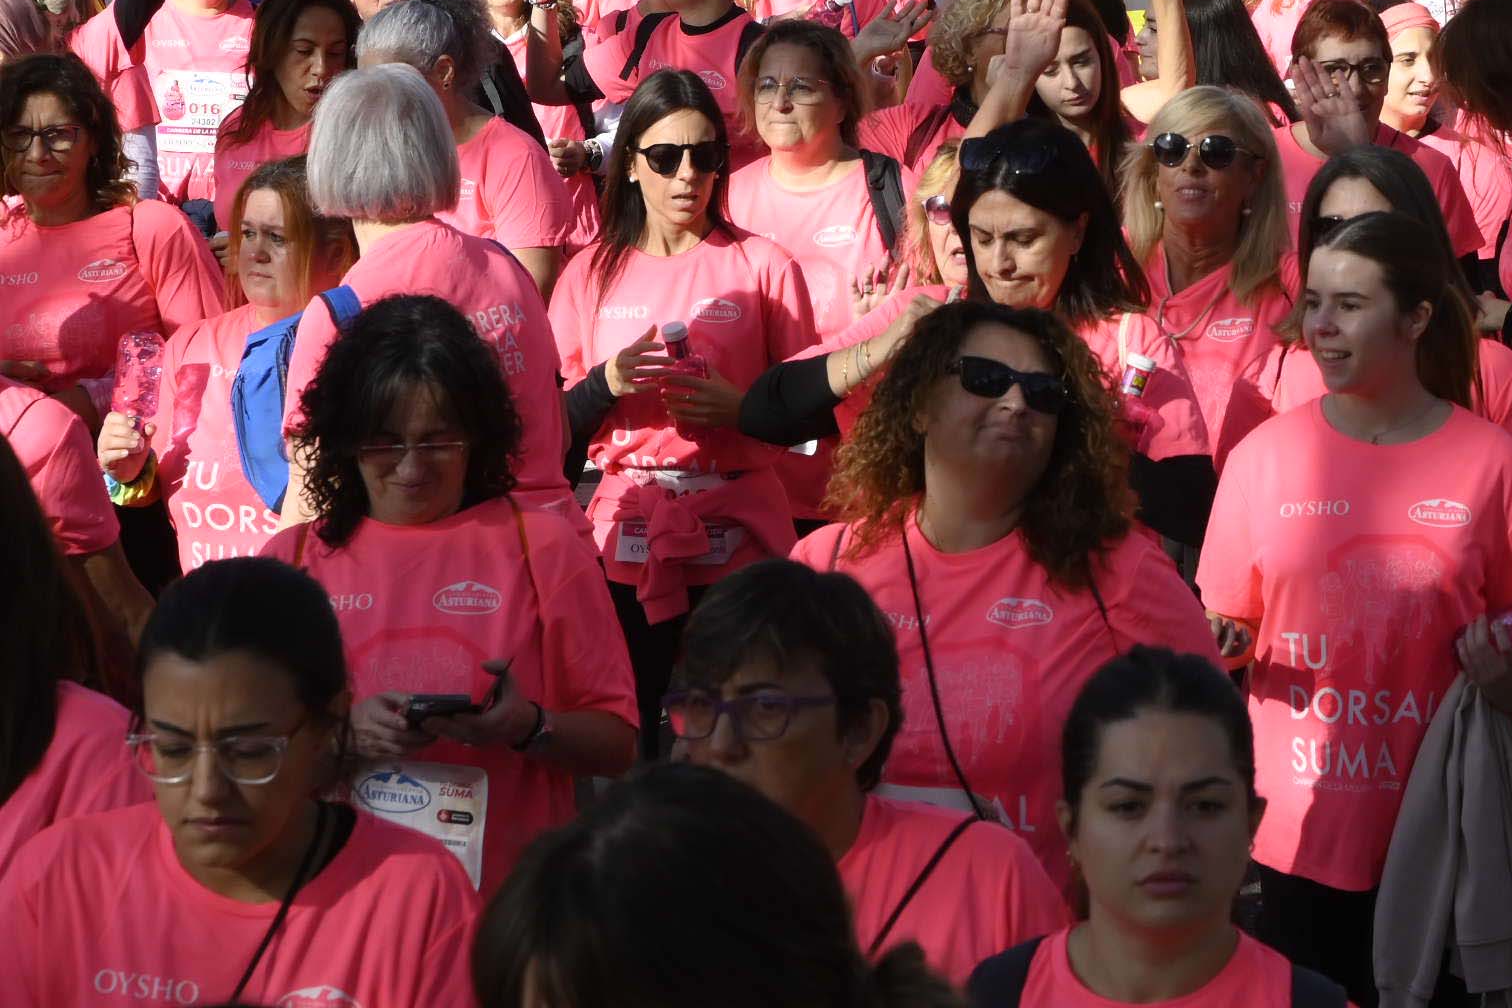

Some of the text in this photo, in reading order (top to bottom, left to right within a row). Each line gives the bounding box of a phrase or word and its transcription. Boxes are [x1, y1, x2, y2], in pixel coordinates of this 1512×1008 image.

[189, 103, 220, 115] 016
[1279, 500, 1350, 518] OYSHO
[1412, 507, 1469, 522] ASTURIANA
[439, 592, 499, 609] ASTURIANA
[1281, 632, 1328, 670] TU
[1291, 737, 1397, 779] SUMA
[361, 785, 424, 805] ASTURIANA
[439, 785, 473, 799] SUMA
[94, 968, 200, 1005] OYSHO
